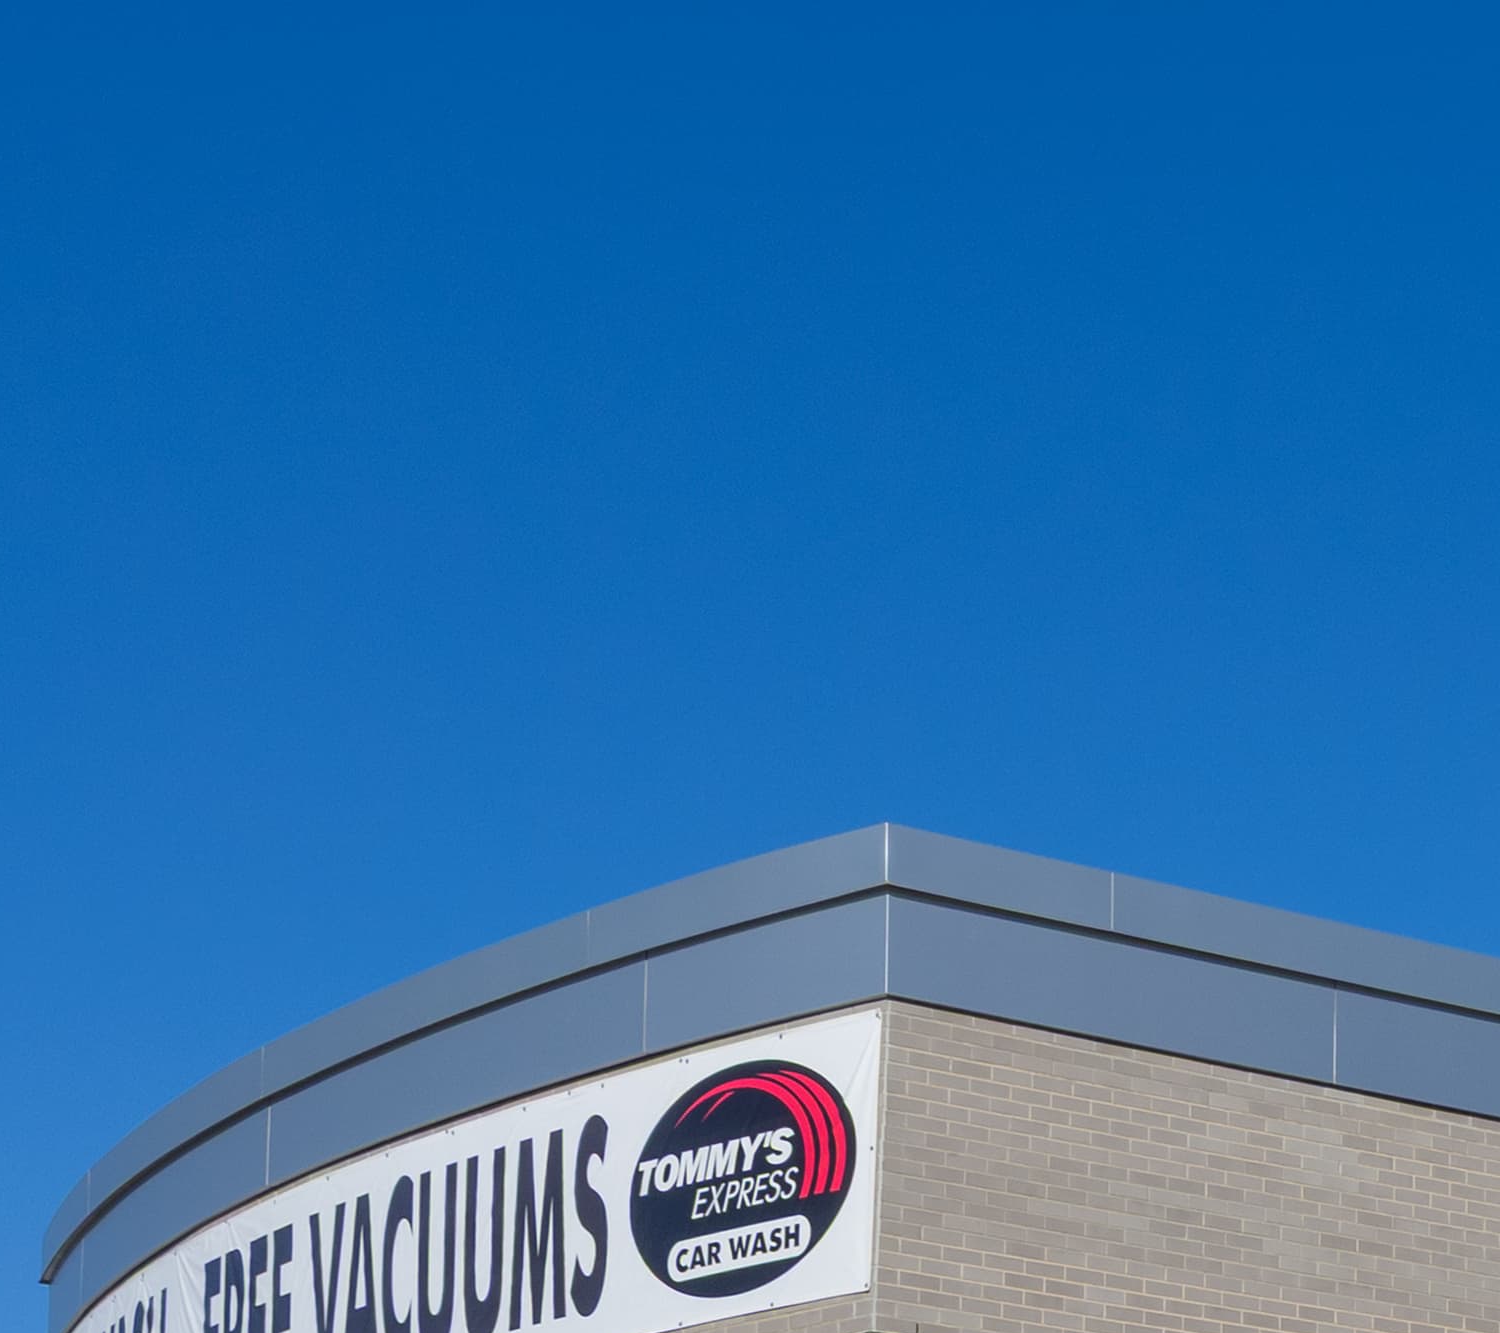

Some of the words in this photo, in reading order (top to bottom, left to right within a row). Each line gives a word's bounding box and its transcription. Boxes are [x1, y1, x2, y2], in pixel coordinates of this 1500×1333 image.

[638, 1127, 795, 1197] TOMMY'S
[691, 1167, 799, 1220] EXPRESS
[675, 1242, 722, 1273] CAR
[729, 1223, 801, 1260] WASH
